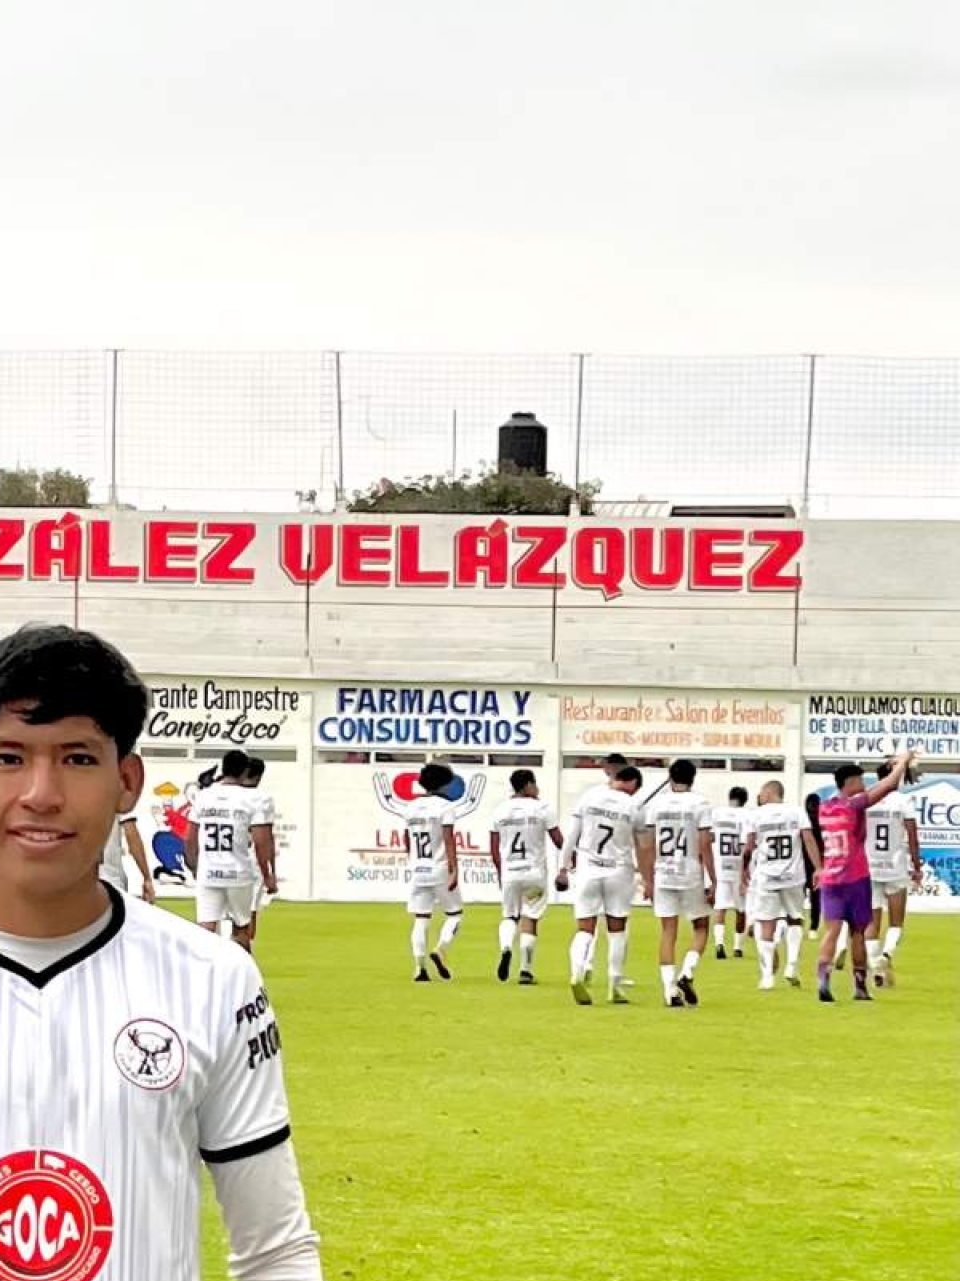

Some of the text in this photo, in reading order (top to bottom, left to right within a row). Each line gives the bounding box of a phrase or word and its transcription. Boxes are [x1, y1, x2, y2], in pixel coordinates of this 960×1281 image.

[278, 519, 805, 601] VELÁZQUEZ
[204, 680, 299, 716] Campestre
[337, 688, 532, 716] FARMACIA Y
[563, 692, 654, 721] Restaurante
[711, 700, 729, 724] de
[732, 699, 785, 725] Eventos
[809, 695, 907, 715] MAQUILAMOS
[149, 710, 221, 744] Conejo
[318, 717, 532, 745] CONSULTORIOS
[809, 718, 827, 734] DE
[204, 823, 235, 852] 33
[412, 831, 433, 859] 12
[511, 831, 526, 860] 4
[597, 823, 615, 855] 7
[658, 826, 687, 857] 24
[765, 835, 793, 862] 38
[875, 824, 889, 852] 9
[347, 864, 399, 881] Sucursal
[68, 1169, 101, 1205] CERDO
